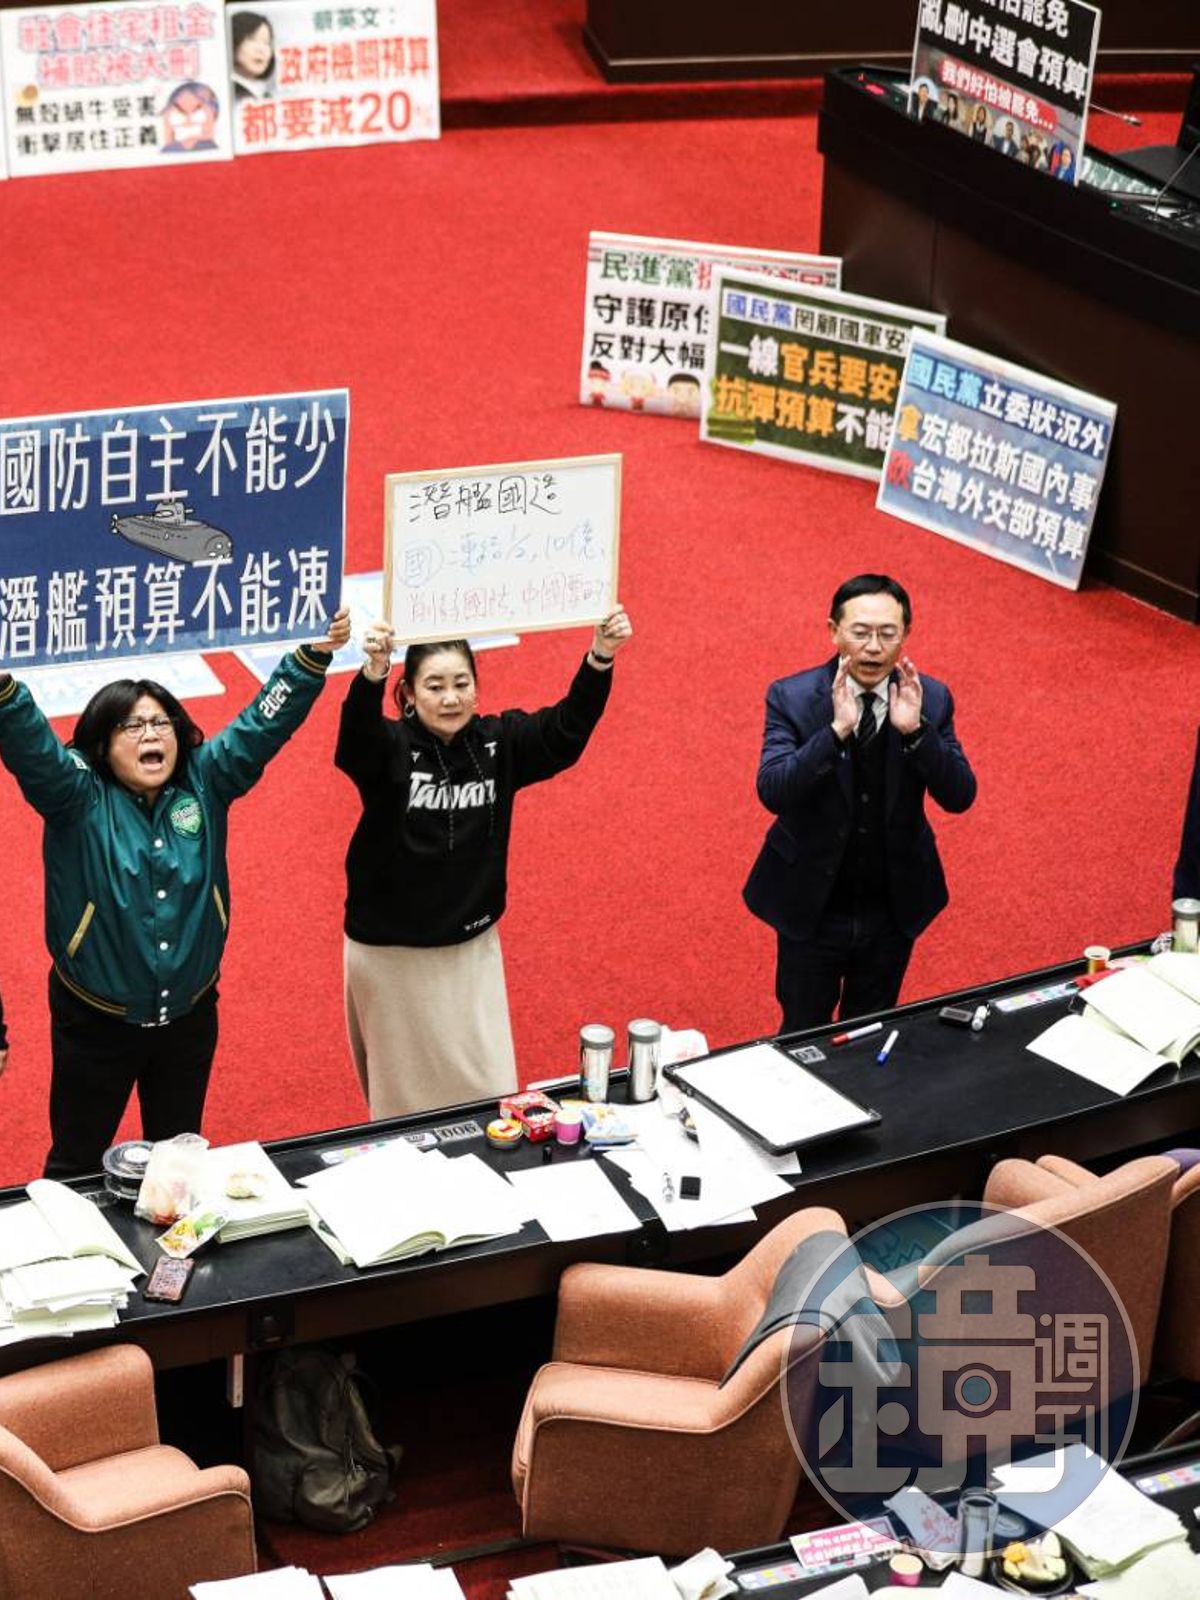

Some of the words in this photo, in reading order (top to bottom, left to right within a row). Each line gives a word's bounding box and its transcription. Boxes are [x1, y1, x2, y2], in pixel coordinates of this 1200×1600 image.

[280, 37, 429, 84] 政府機關預算
[18, 126, 157, 155] 衝擊居住正義
[906, 353, 1105, 457] 國民黨立委狀況外
[0, 401, 336, 515] 國防自主不能少
[898, 404, 1098, 512] 拿宏都拉斯國內事
[409, 473, 563, 523] 潛艦國造
[259, 679, 292, 720] 2024
[406, 772, 497, 813] Taiwan
